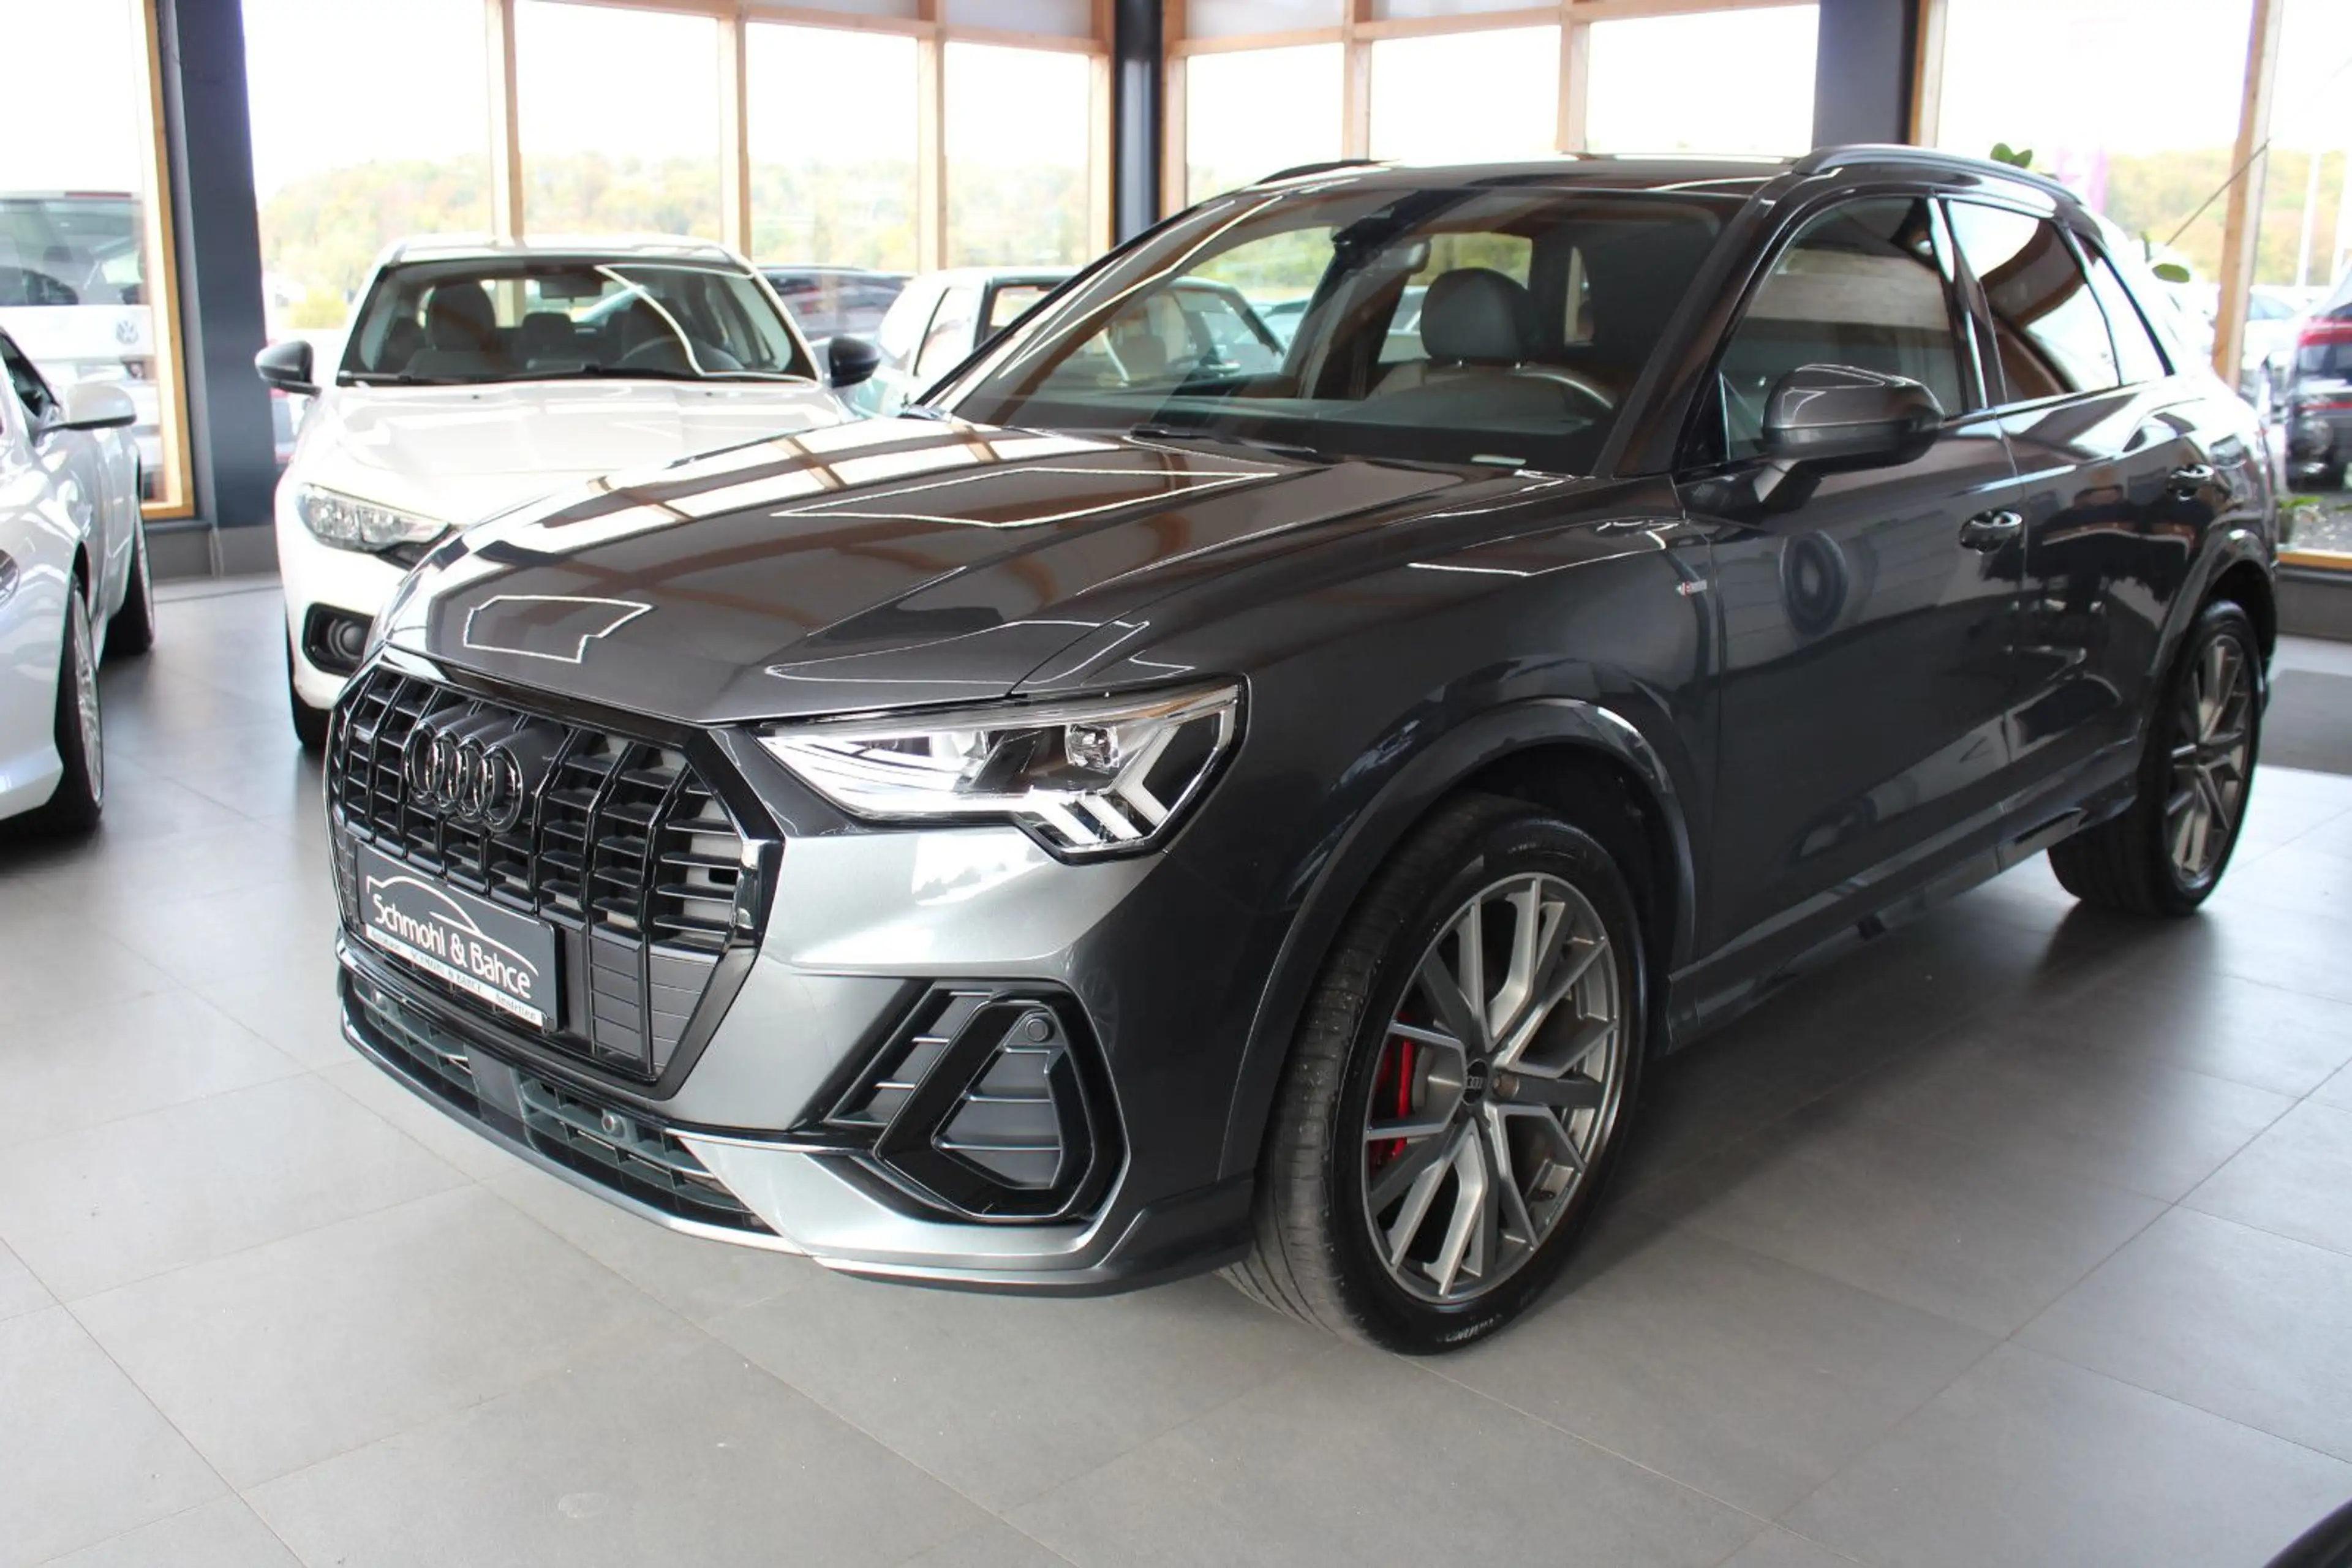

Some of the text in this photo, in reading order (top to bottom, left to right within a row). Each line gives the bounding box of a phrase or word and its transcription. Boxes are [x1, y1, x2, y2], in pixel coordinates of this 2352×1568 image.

[372, 893, 446, 957] Schmohl
[451, 933, 468, 968] &
[470, 941, 531, 999] Bahce
